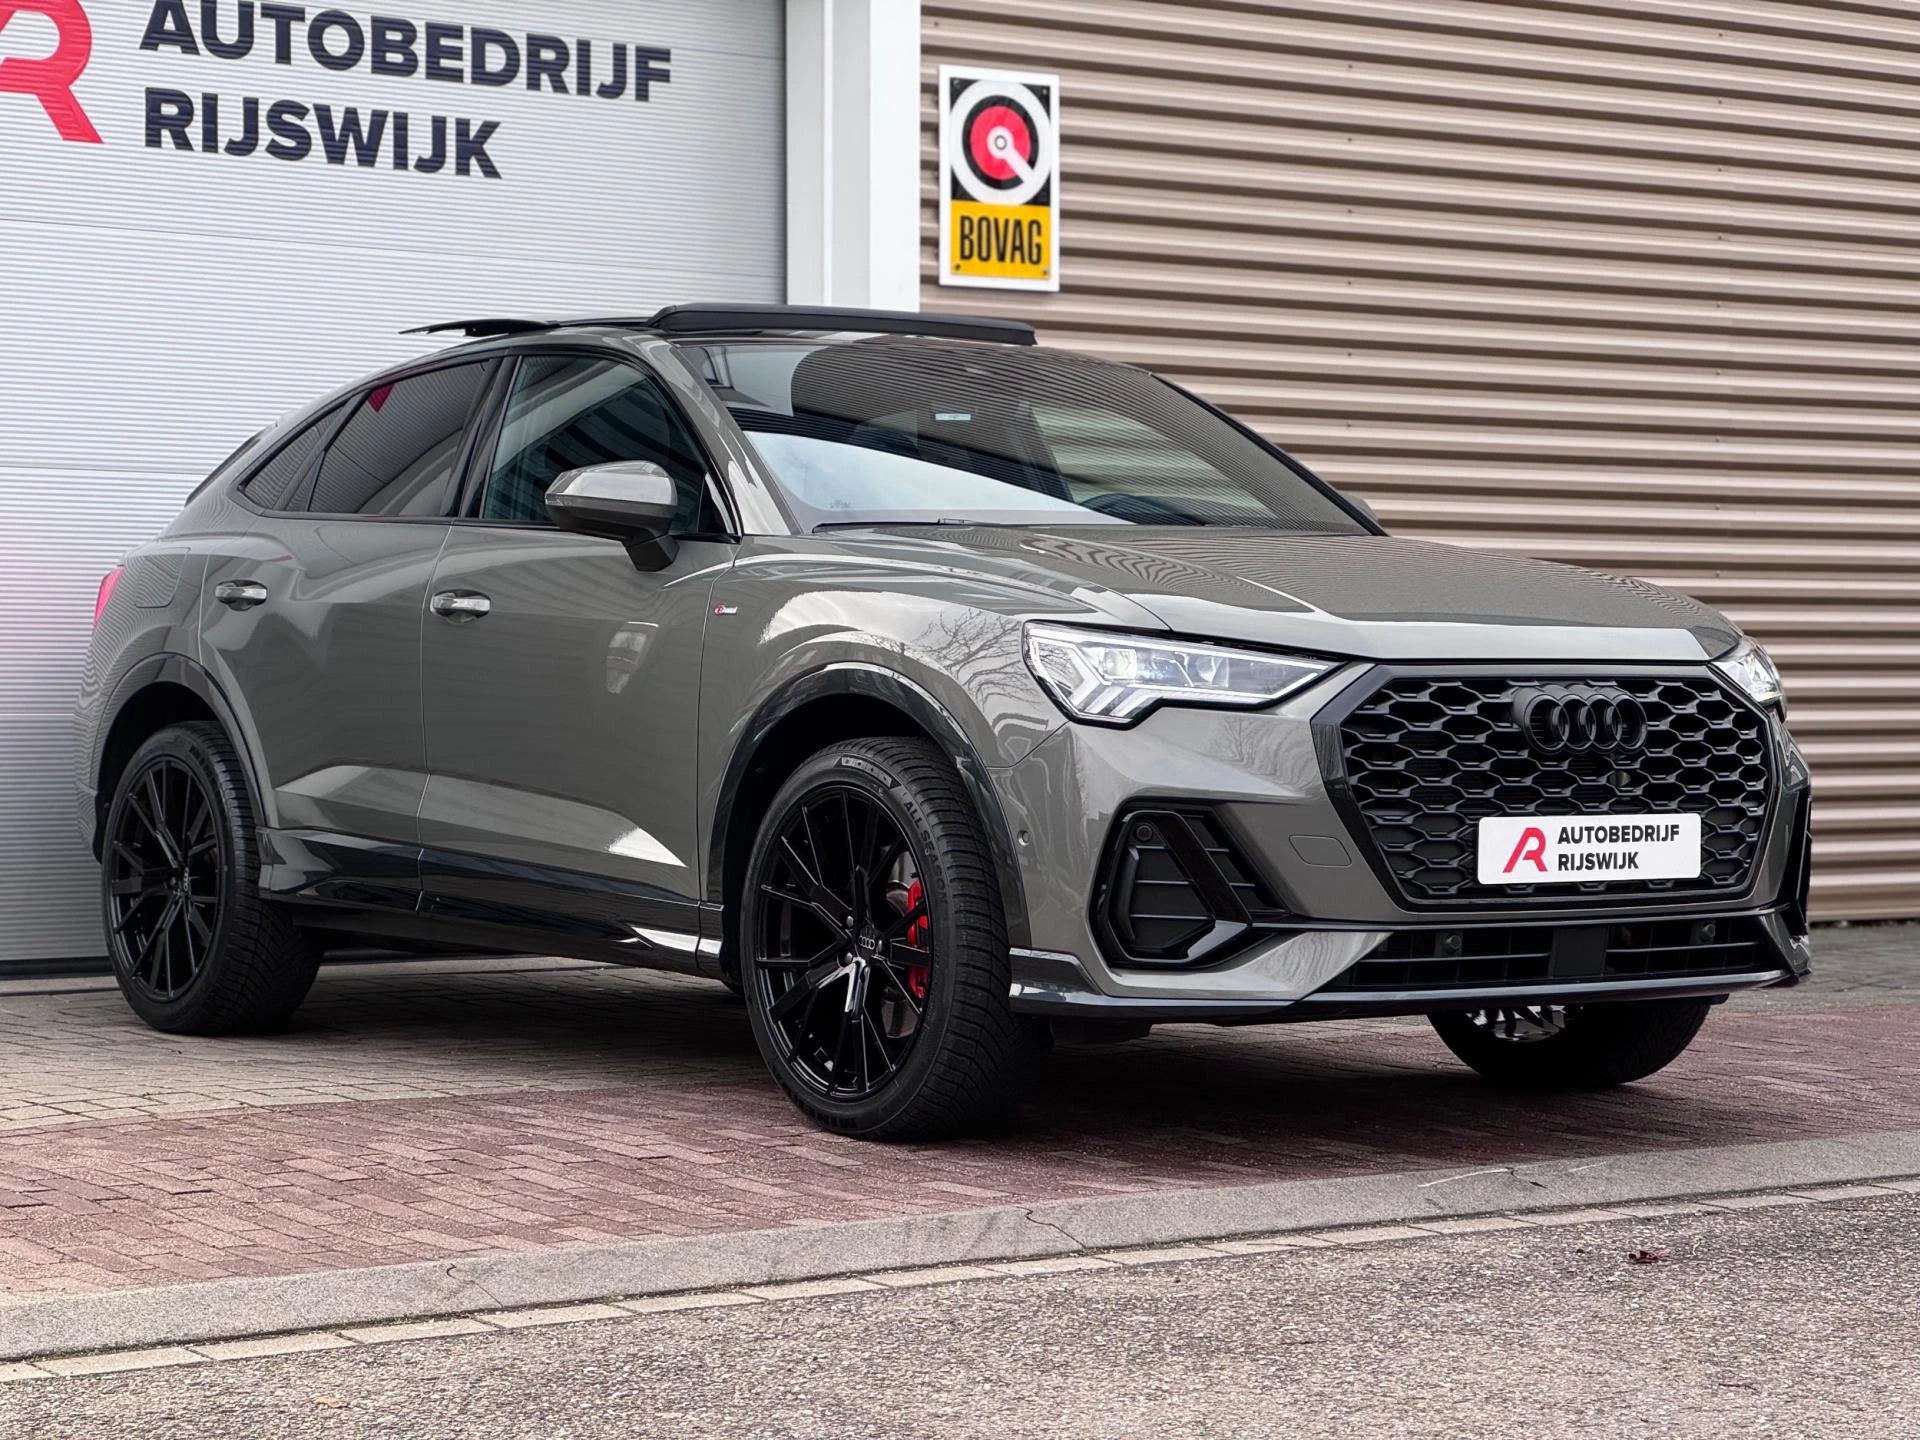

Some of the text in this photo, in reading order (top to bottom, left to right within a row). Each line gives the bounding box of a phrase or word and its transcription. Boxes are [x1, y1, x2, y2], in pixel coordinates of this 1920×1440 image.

[139, 0, 672, 102] AUTOBEDRIJF
[144, 87, 503, 179] RIJSWIJK
[960, 215, 1042, 265] BOVAG
[1557, 824, 1680, 845] AUTOBEDRIJF
[1557, 851, 1639, 871] RIJSWIJK
